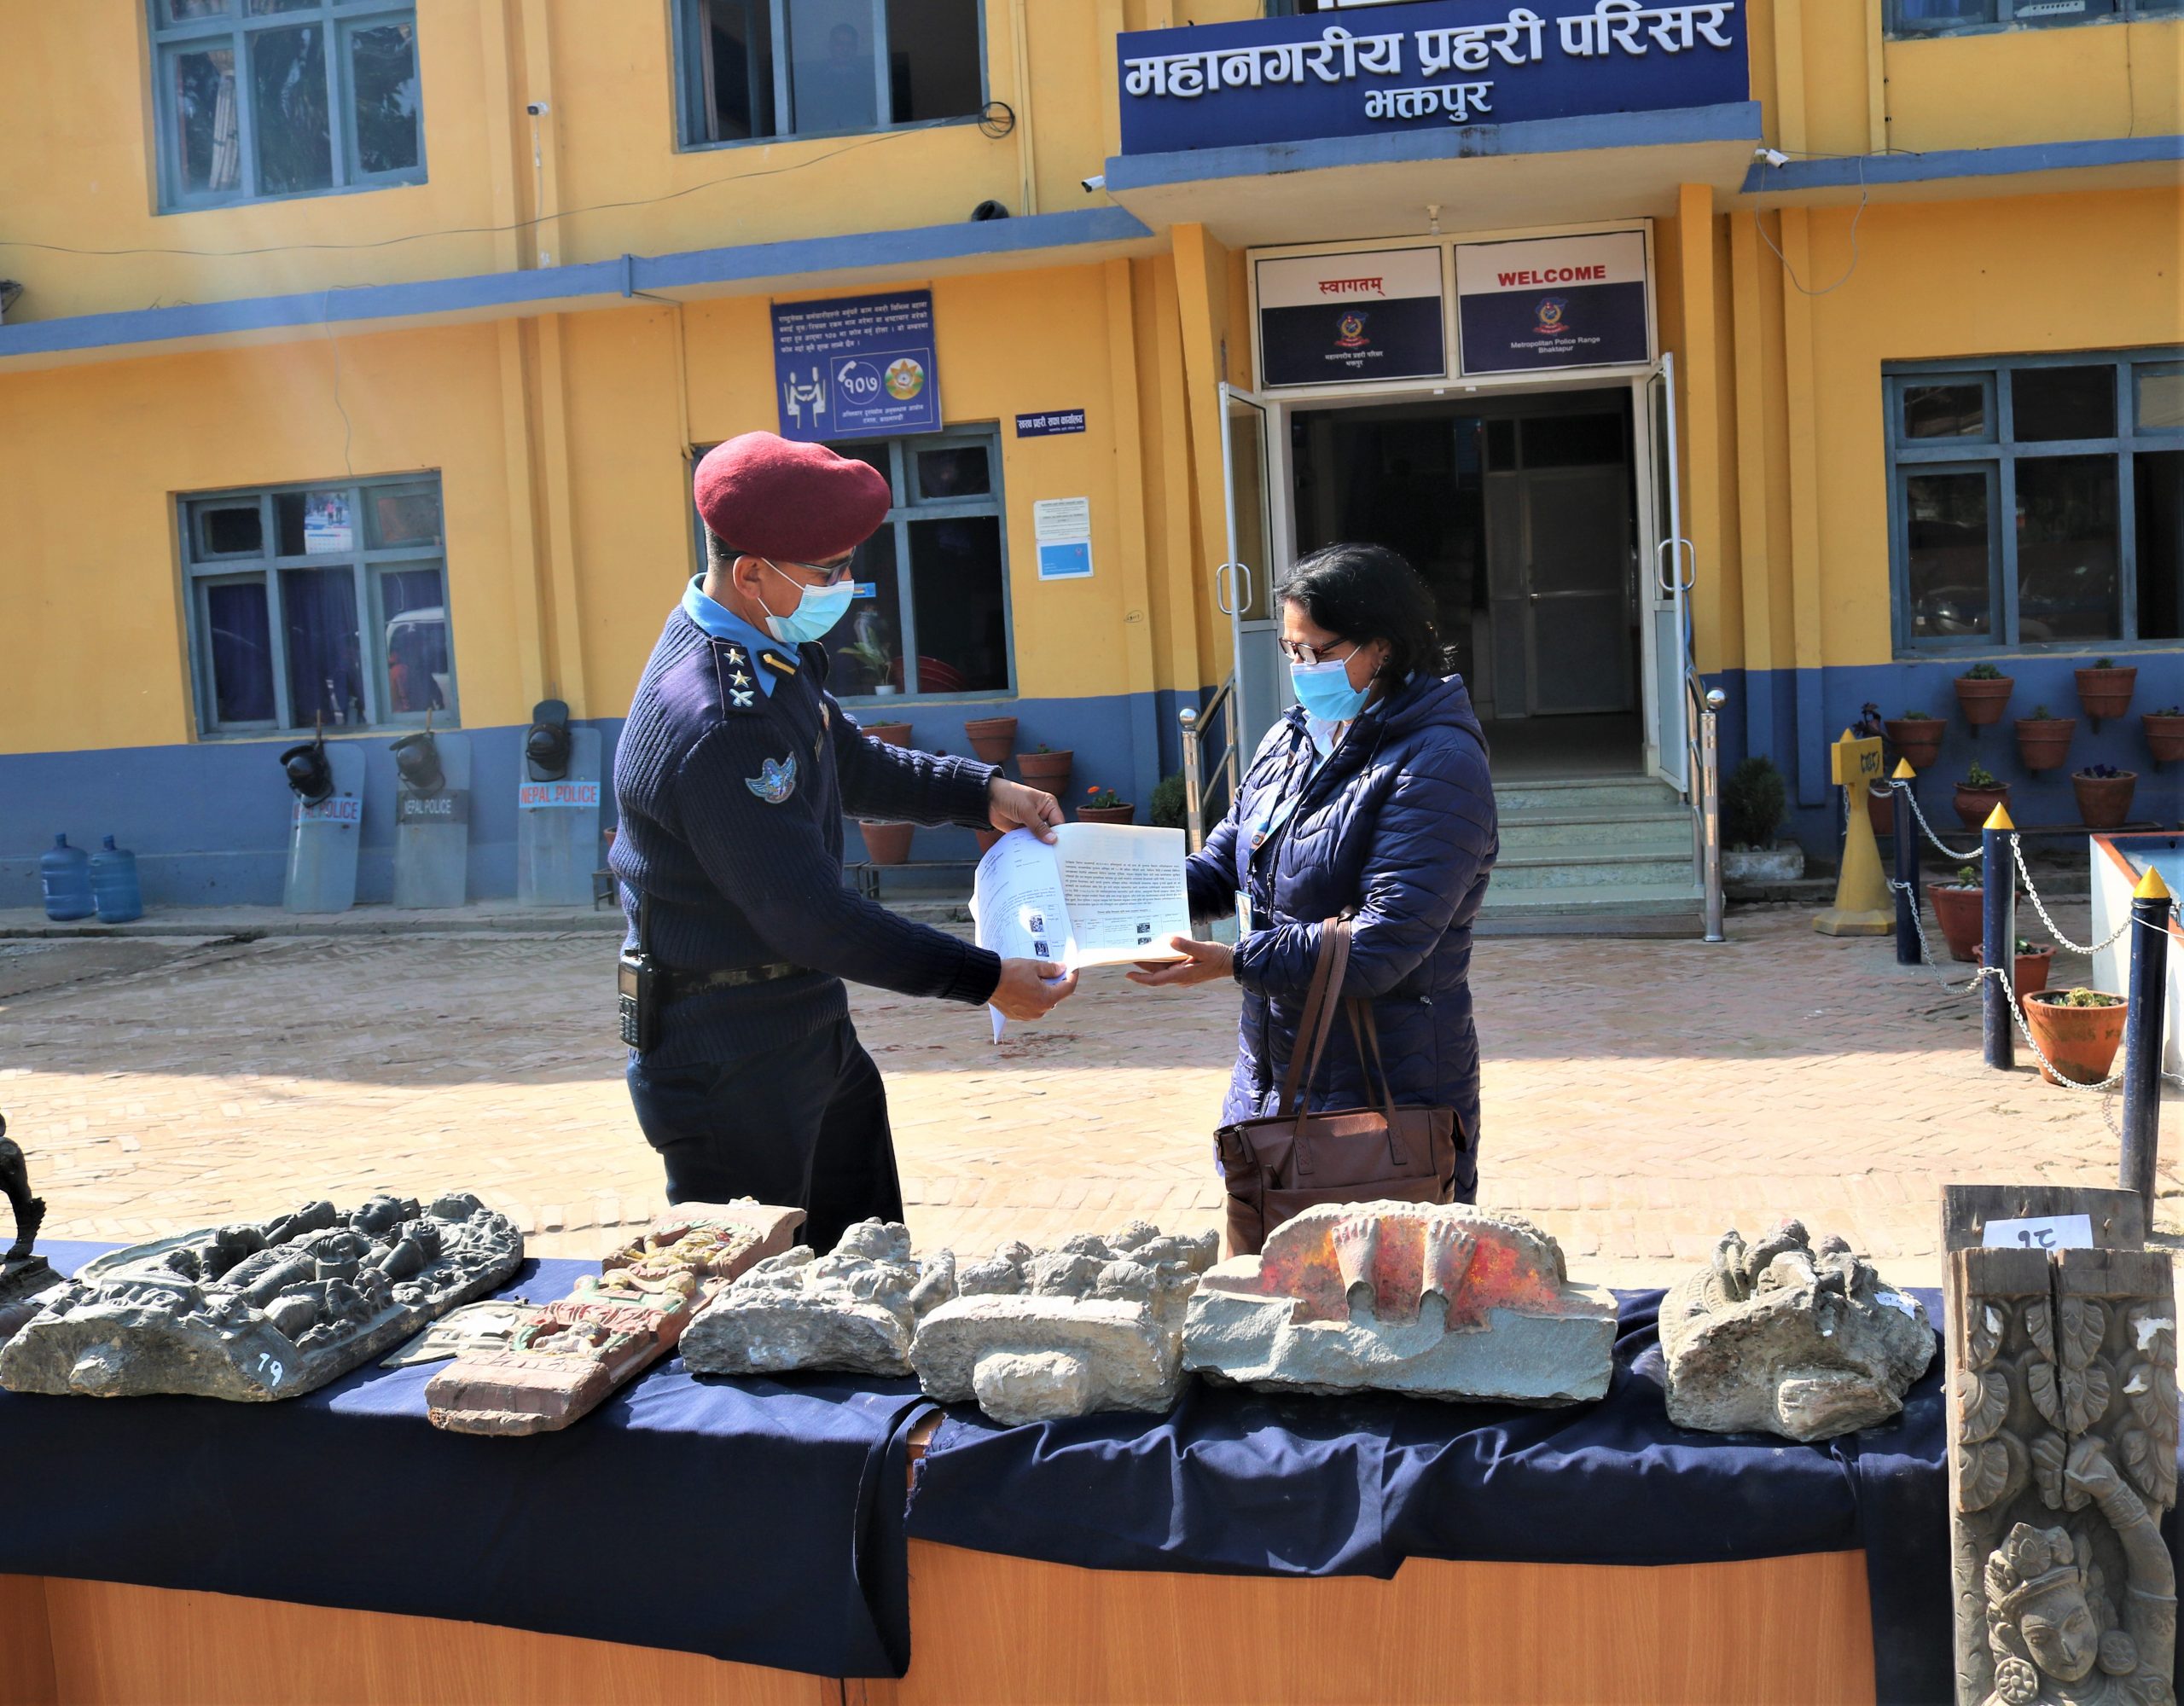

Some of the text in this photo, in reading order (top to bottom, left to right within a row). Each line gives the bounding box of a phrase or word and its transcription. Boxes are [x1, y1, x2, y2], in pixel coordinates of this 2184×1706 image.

[1124, 0, 1735, 98] महानगरीय प्रहरी परिसर
[1364, 81, 1494, 123] भक्तपुर
[1498, 264, 1606, 287] WELCOME
[1318, 277, 1385, 296] स्वागतम्
[1511, 339, 1554, 349] Metropolitan
[1577, 336, 1600, 345] Range
[1538, 345, 1574, 354] Bhaktapur
[844, 376, 878, 394] १०७
[520, 783, 599, 805] NEPAL POLICE
[404, 798, 452, 815] NEPAL POLICE
